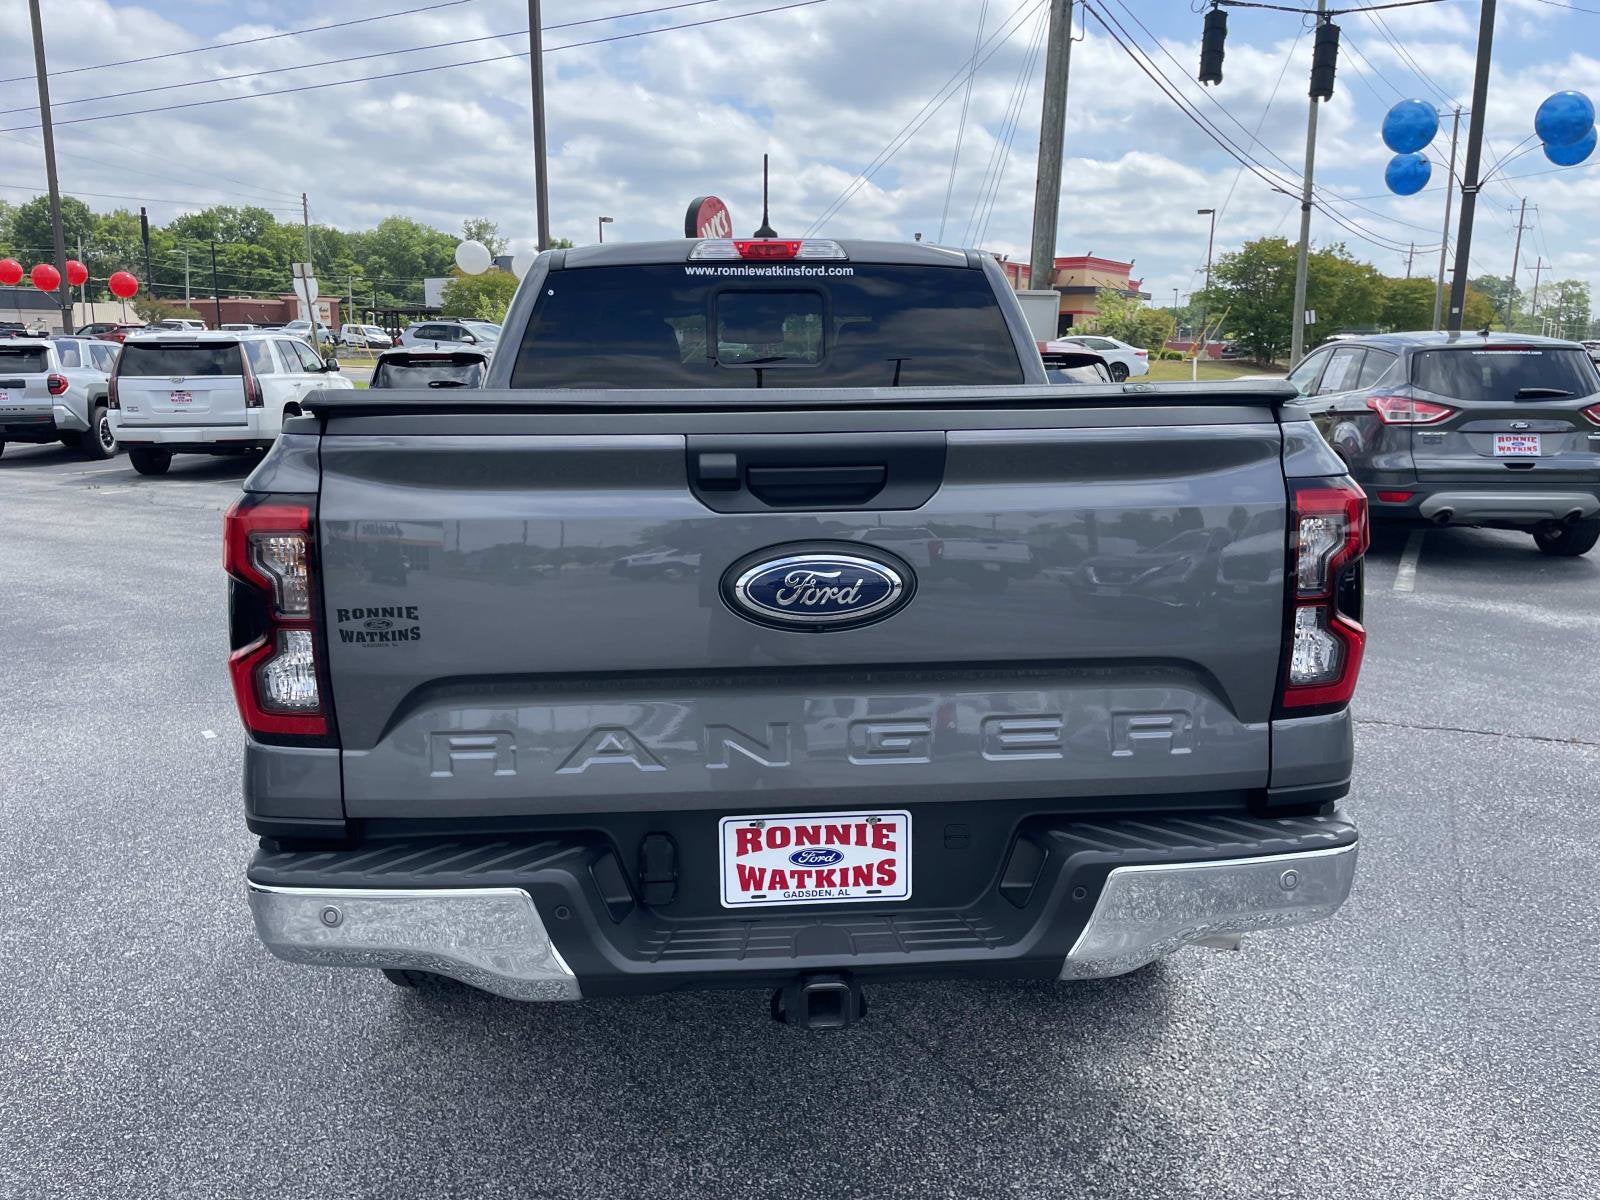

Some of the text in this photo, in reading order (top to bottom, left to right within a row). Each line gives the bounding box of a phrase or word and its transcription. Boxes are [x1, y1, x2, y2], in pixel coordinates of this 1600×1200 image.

[684, 265, 854, 277] www.ronniewatkinsford.com
[775, 569, 864, 606] Ford
[336, 606, 419, 623] RONNIE
[338, 626, 421, 643] WATKINS
[429, 709, 1193, 777] RANGER
[735, 823, 897, 857] RONNIE
[797, 850, 838, 864] Ford
[735, 858, 897, 892] WATKINS
[783, 889, 851, 899] GADSDEN, AL
